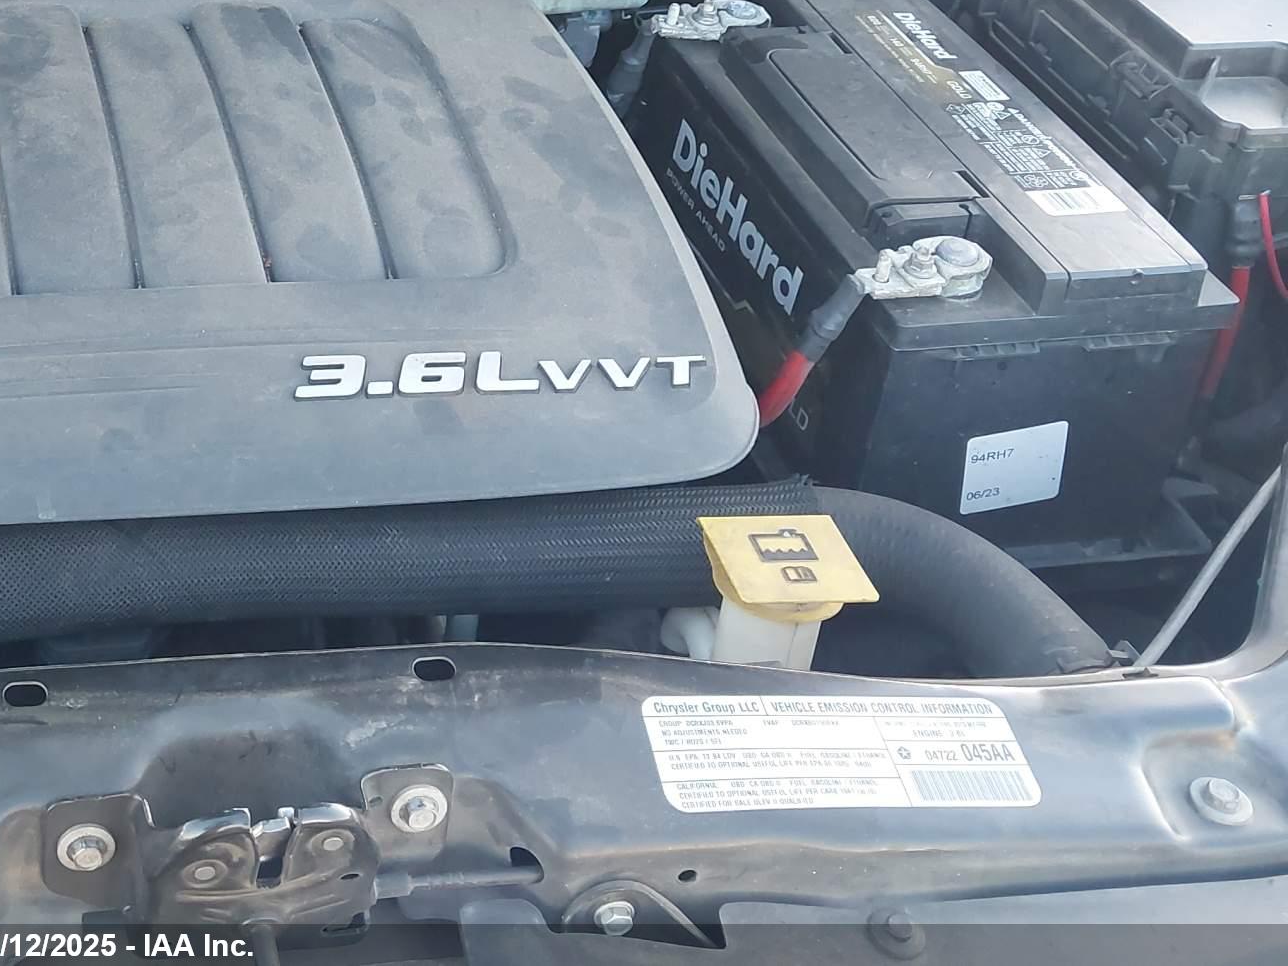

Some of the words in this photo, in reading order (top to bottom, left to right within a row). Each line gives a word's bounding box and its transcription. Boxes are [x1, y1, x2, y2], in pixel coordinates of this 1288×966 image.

[893, 12, 958, 59] DieHard
[946, 81, 972, 99] GOLD
[667, 168, 694, 209] POWER
[696, 210, 725, 252] AHEAD
[672, 118, 804, 315] DieHard
[971, 449, 1014, 464] 94RH7
[966, 487, 1000, 500] 06/23
[653, 701, 699, 714] Chrysler
[702, 702, 736, 715] Group
[738, 701, 760, 713] LLC
[771, 701, 815, 713] VEHICLE
[818, 702, 868, 714] EMISSION
[871, 703, 918, 714] CONTROL
[922, 703, 993, 714] INFORMATION
[924, 750, 959, 761] 04722
[961, 743, 1015, 761] 045AA
